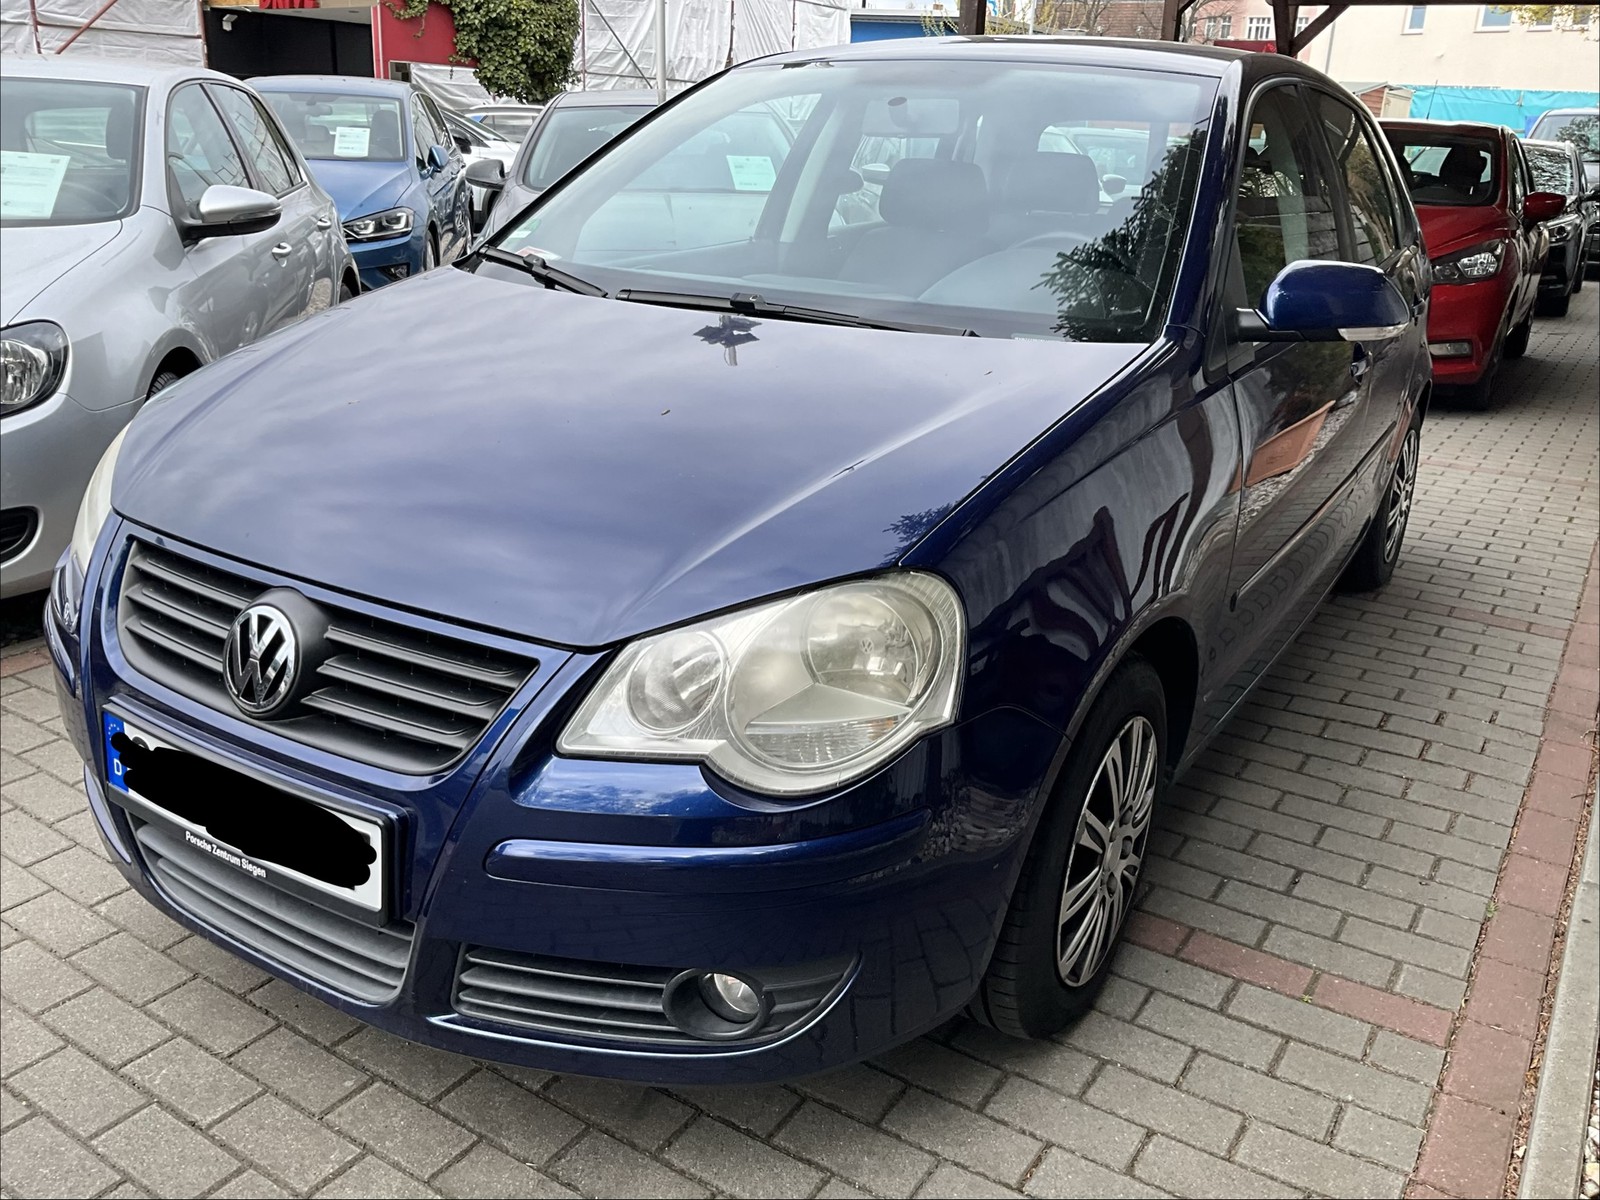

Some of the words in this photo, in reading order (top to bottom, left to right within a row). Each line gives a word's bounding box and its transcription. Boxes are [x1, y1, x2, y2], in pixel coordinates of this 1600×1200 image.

[227, 605, 296, 712] VW
[113, 757, 123, 776] D
[185, 830, 212, 853] Porsche
[211, 843, 241, 867] Zentrum
[241, 857, 267, 878] Siegen
